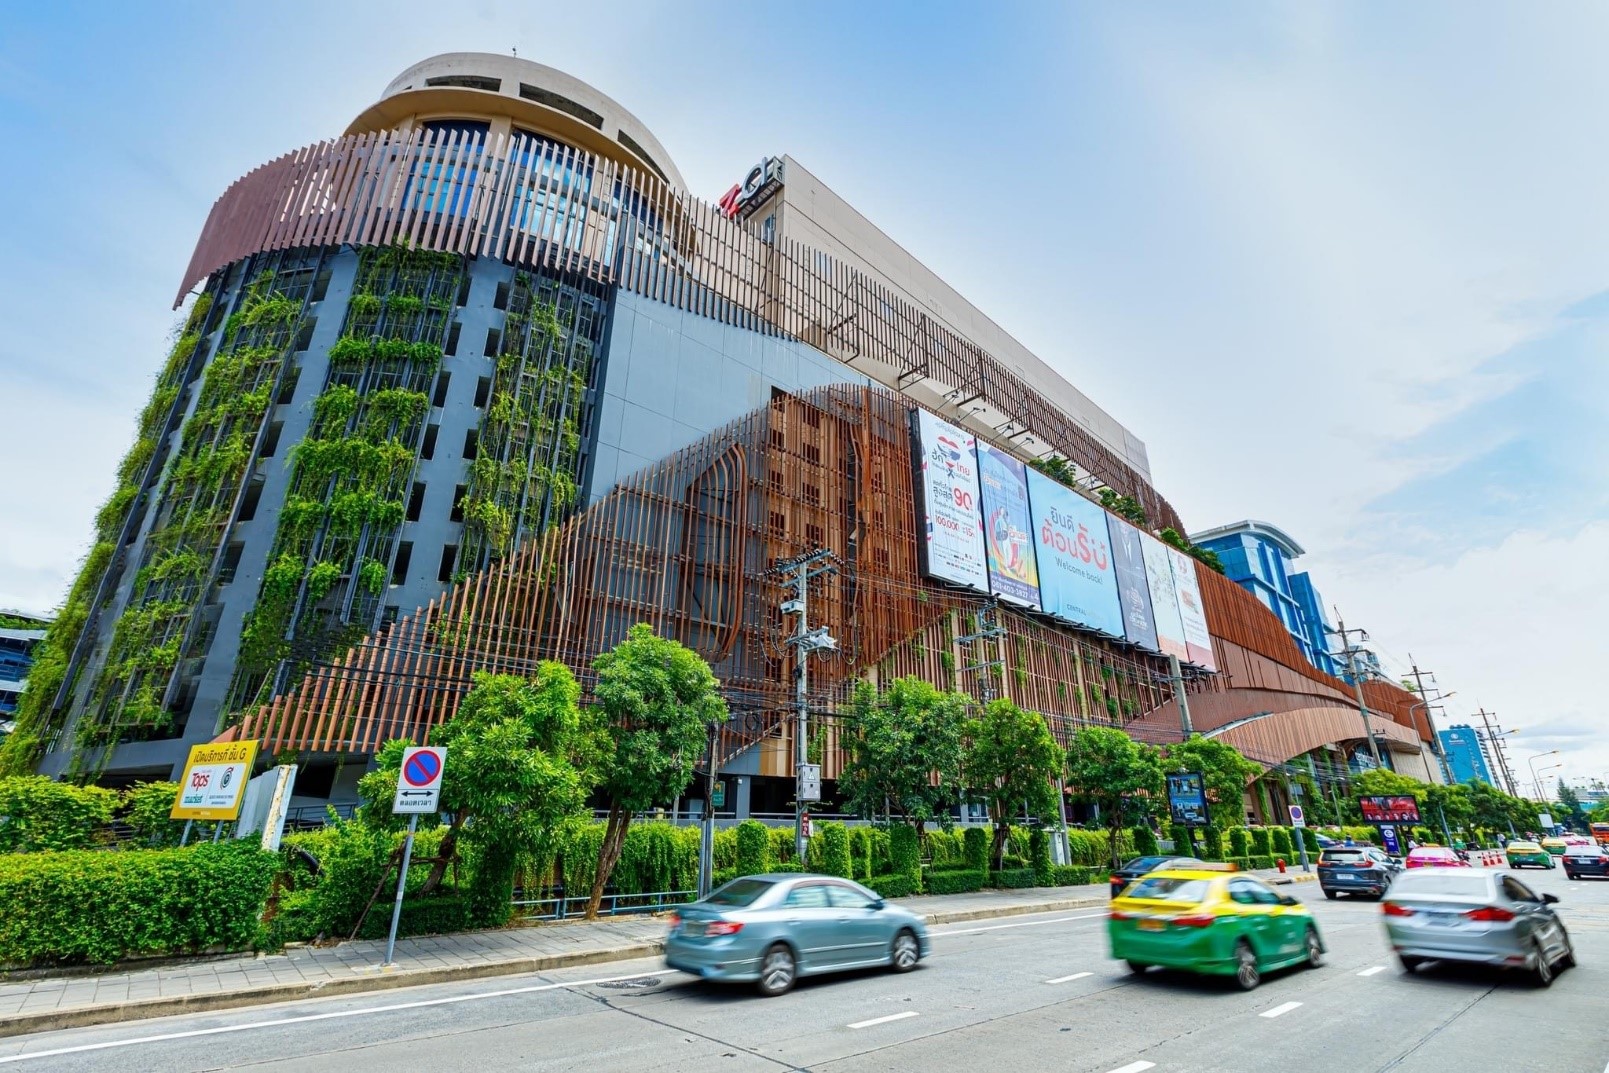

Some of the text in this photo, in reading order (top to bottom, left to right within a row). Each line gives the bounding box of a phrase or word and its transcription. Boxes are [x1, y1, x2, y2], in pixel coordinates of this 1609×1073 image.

[1050, 506, 1074, 532] ยินดี
[1055, 556, 1085, 577] Welcome
[239, 748, 247, 760] G
[191, 772, 210, 792] Tops
